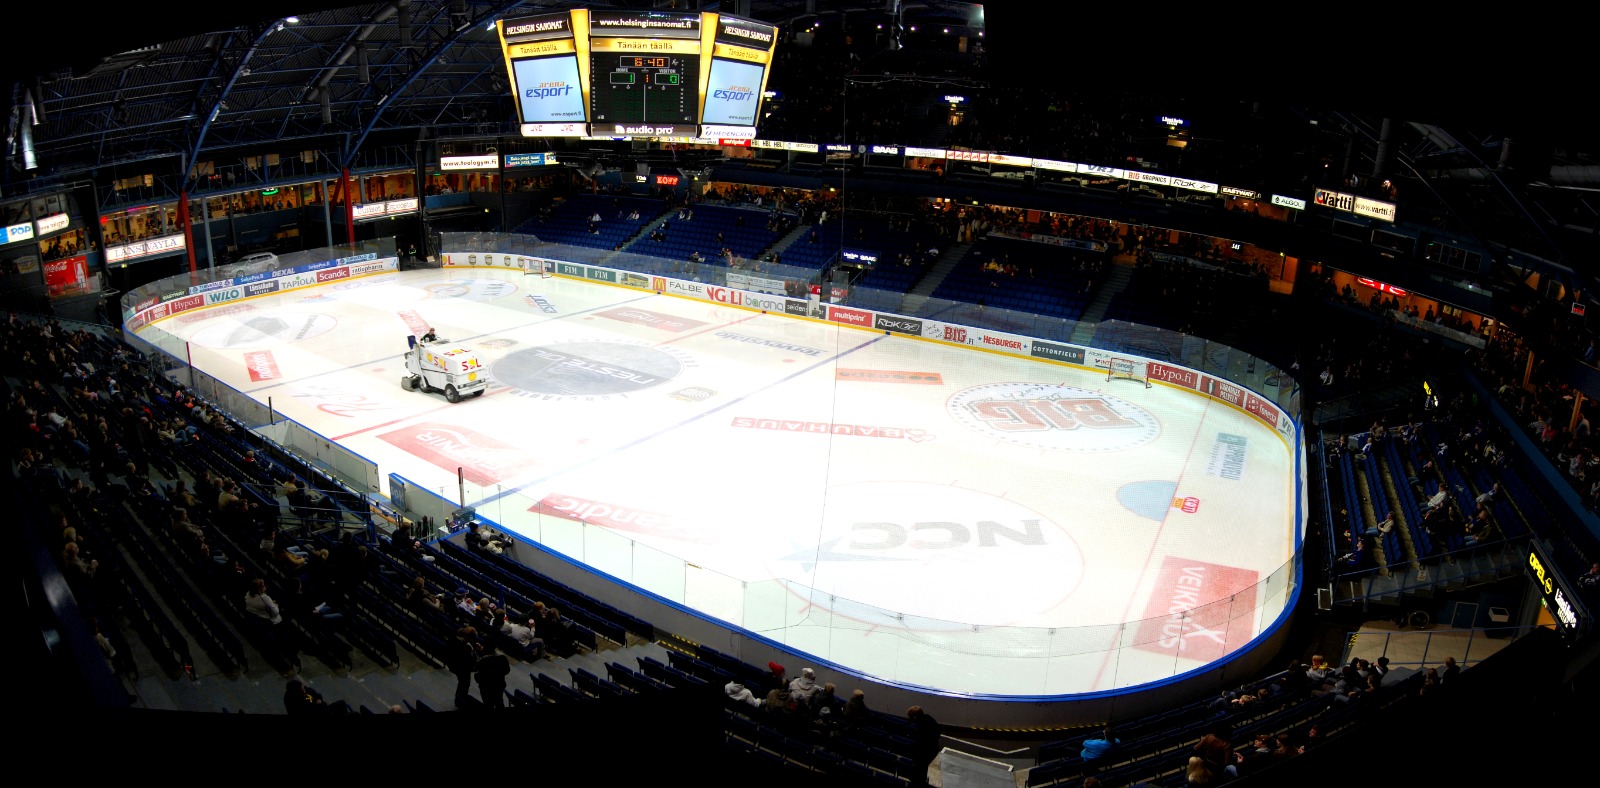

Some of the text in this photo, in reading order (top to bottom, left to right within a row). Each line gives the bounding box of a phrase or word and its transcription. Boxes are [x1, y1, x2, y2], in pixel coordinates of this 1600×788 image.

[506, 21, 563, 35] HELSINGIN SANOMAT
[600, 19, 692, 28] www.helsinginsanomat.fi
[724, 26, 772, 42] HELSINGIN SANOMAT
[634, 57, 665, 67] 6:40
[525, 84, 573, 99] esport
[713, 89, 754, 102] esport
[626, 126, 673, 137] audio pro
[1321, 191, 1353, 211] Vartti
[1354, 201, 1395, 218] www.vartti.fi
[10, 226, 32, 236] POP
[271, 267, 296, 278] DEXAL
[319, 268, 348, 281] Scandic
[564, 265, 578, 275] FIM
[594, 270, 609, 279] FIM
[669, 281, 702, 293] FALBE
[209, 289, 240, 303] WILO
[174, 297, 201, 311] Hypo.fi
[745, 295, 784, 312] barona
[834, 311, 867, 322] multiprint
[983, 335, 1022, 350] HESBURGER
[1032, 345, 1077, 359] COTTONFIELD
[1152, 364, 1192, 384] Hypo.fi
[968, 398, 1145, 432] BIG
[733, 418, 905, 438] BAUHAUS
[850, 519, 1049, 550] NCC
[1529, 552, 1546, 586] OPEL
